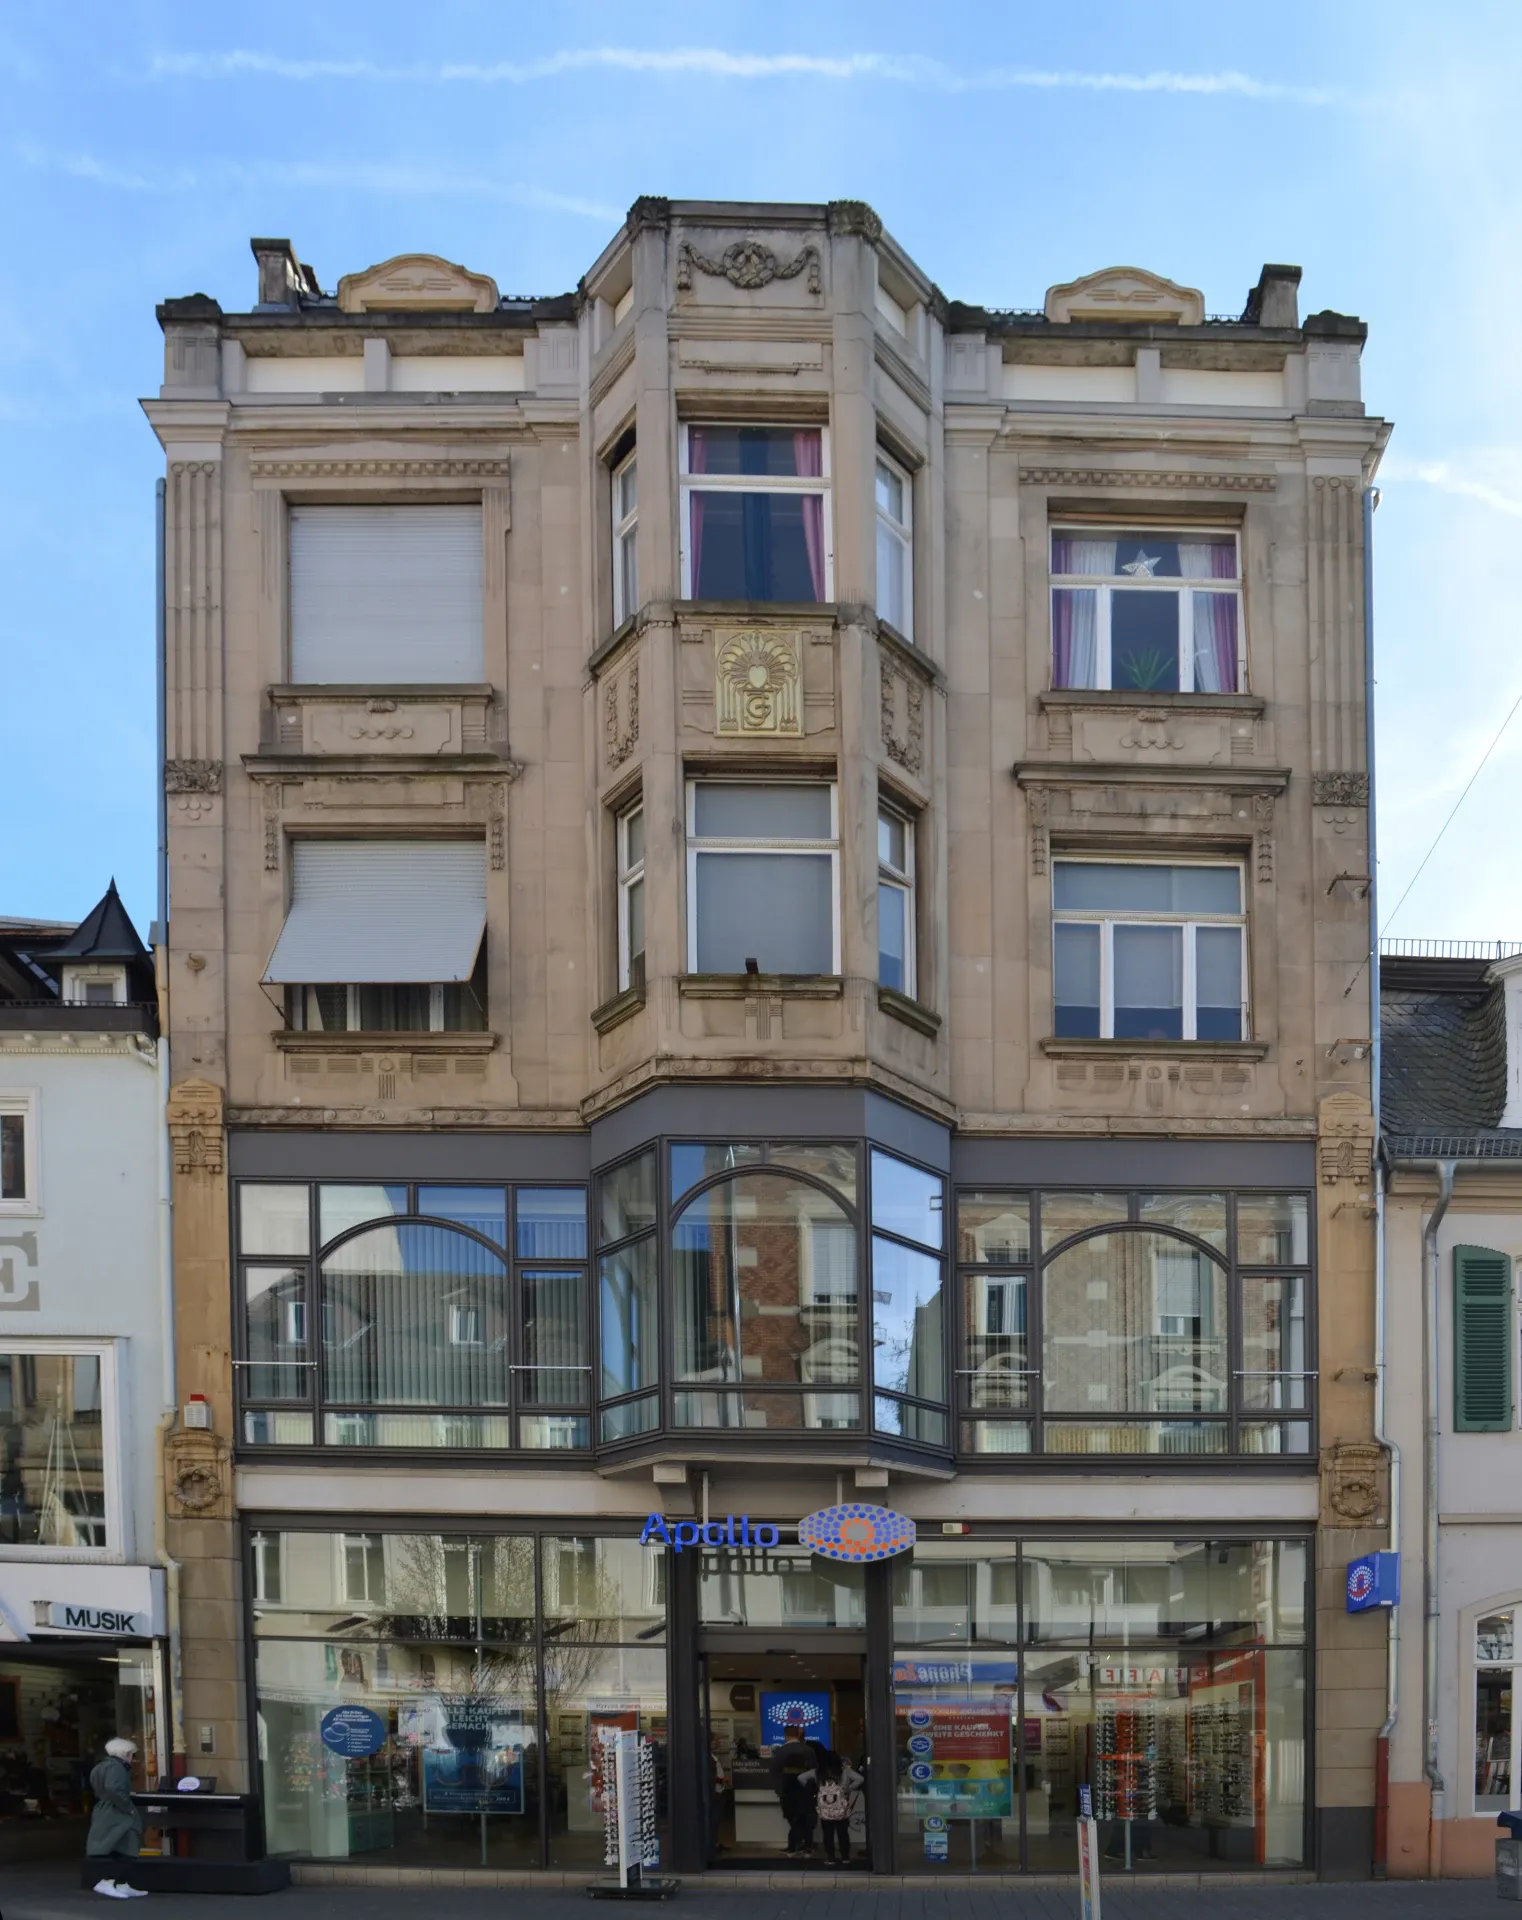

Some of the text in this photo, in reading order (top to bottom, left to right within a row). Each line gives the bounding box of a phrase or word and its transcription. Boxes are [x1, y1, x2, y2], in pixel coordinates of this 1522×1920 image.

[639, 1512, 780, 1553] Apollo
[65, 1607, 135, 1633] MUSIK
[469, 1707, 511, 1715] KAUFEN
[954, 1730, 1005, 1738] GESCHENKT
